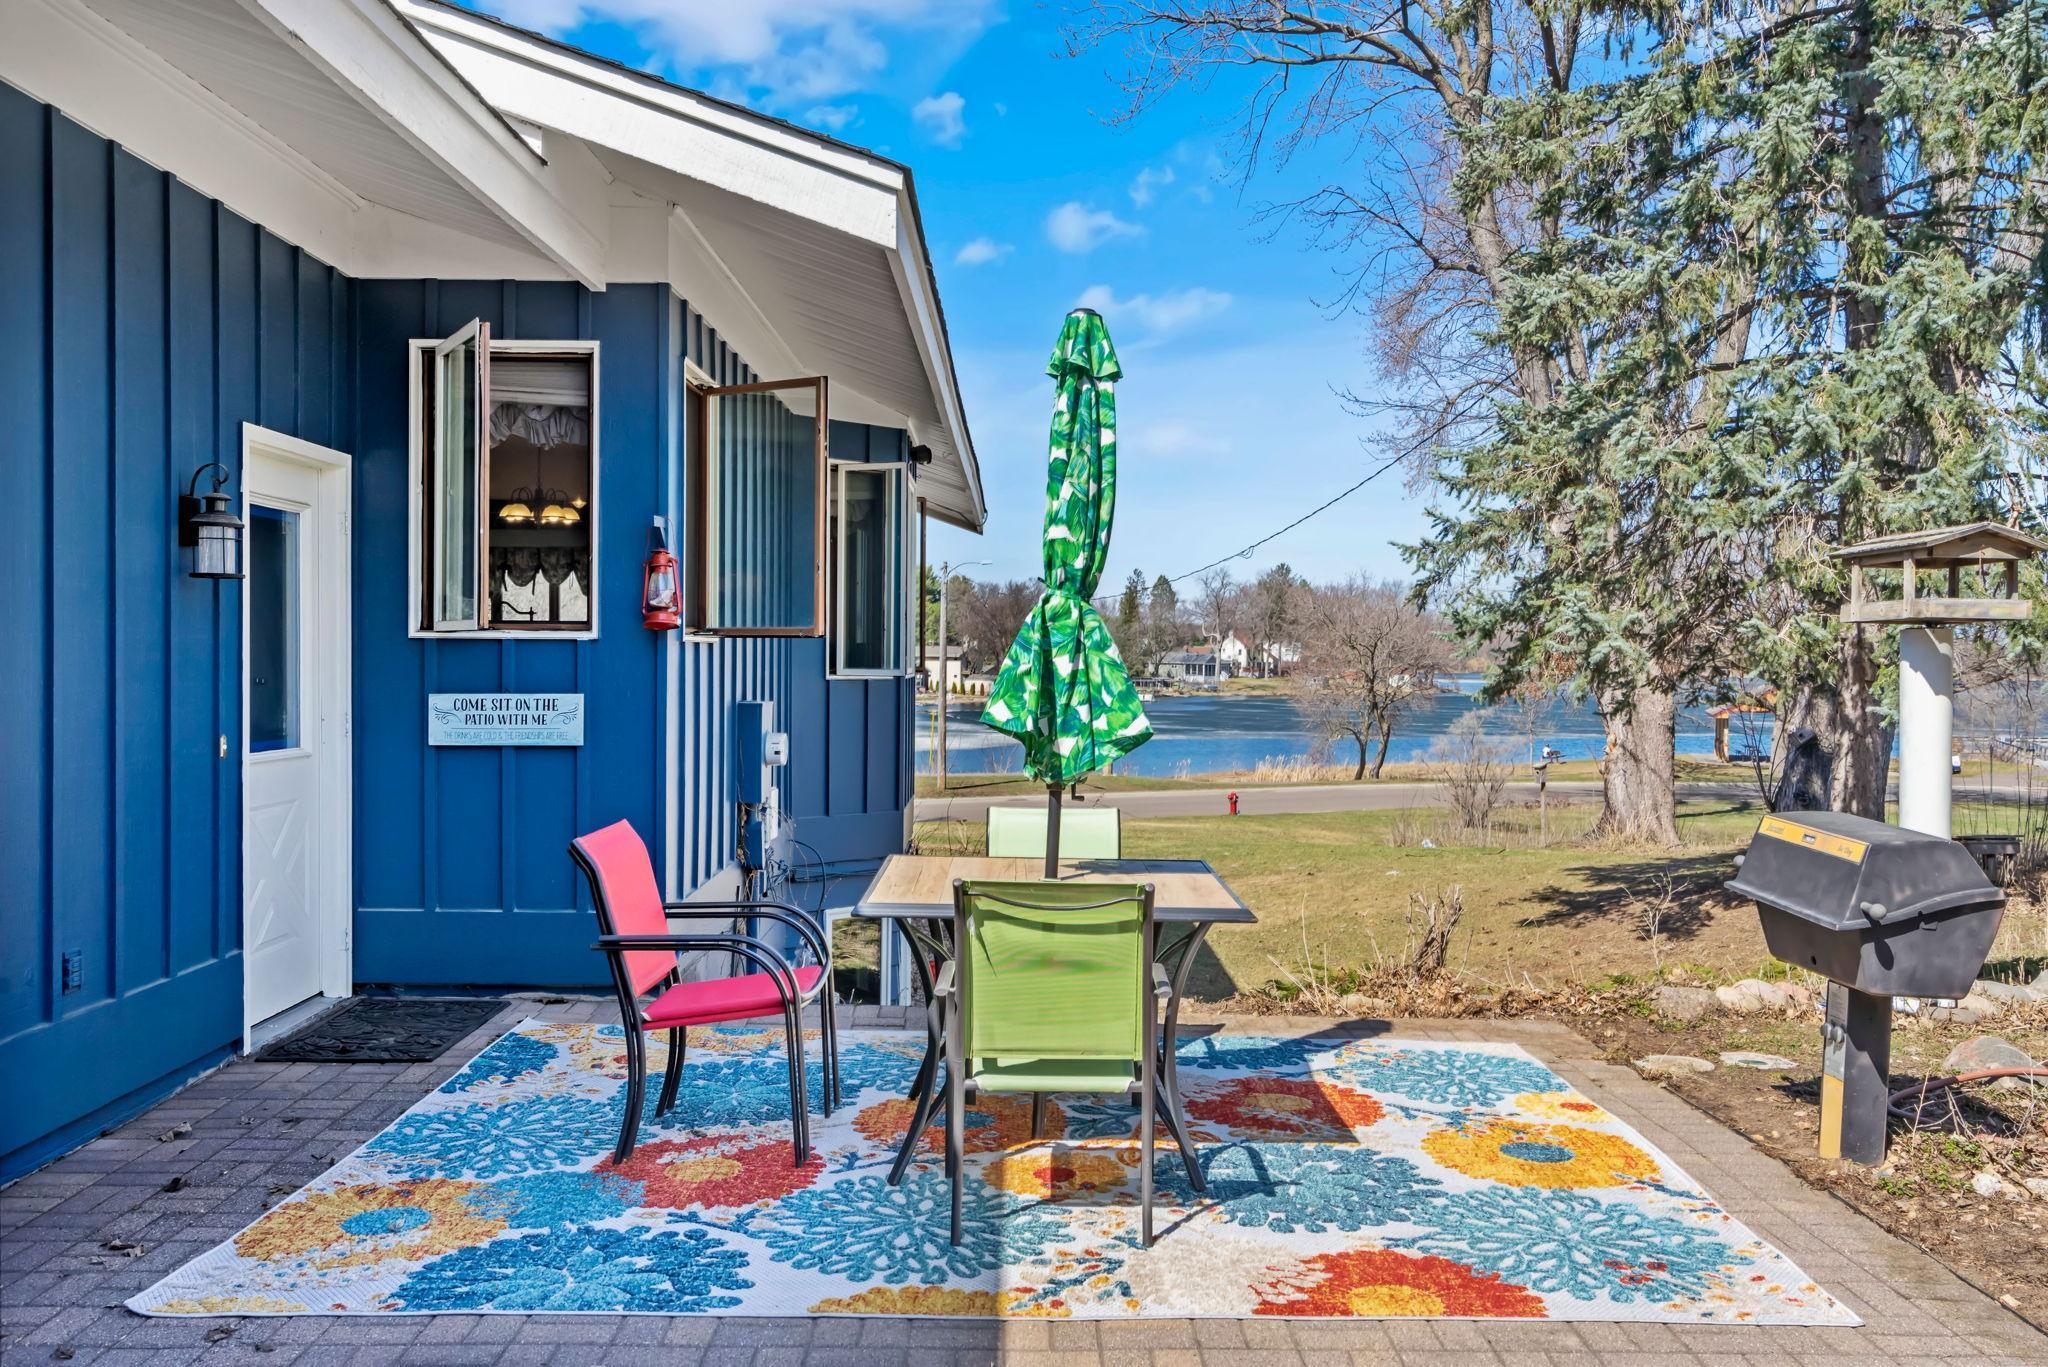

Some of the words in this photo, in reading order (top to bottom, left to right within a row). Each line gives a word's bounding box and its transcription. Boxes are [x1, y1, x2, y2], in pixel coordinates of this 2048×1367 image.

[453, 698, 487, 711] COME
[491, 698, 511, 711] SIT
[515, 698, 531, 711] ON
[533, 698, 559, 711] THE
[465, 714, 494, 725] PATIO
[497, 714, 528, 725] WITH
[532, 714, 548, 725] ME
[444, 731, 453, 740] THE
[471, 731, 482, 740] ARE
[483, 731, 497, 740] COLD
[504, 731, 513, 740] THE
[546, 731, 555, 740] ARE
[556, 731, 568, 740] FREE
